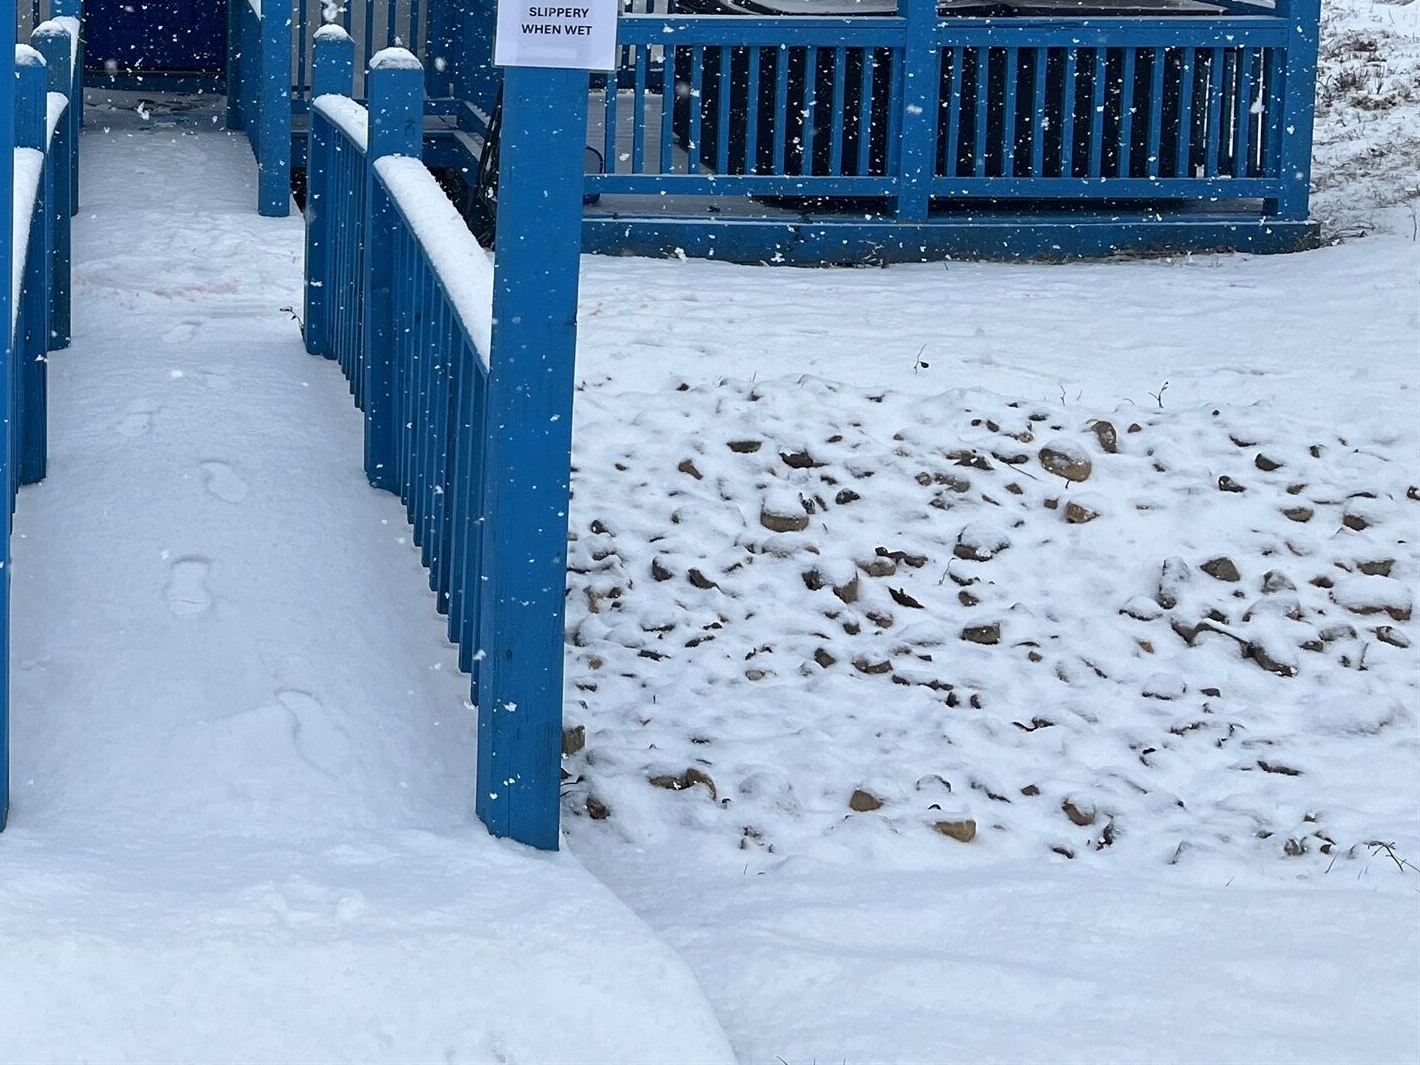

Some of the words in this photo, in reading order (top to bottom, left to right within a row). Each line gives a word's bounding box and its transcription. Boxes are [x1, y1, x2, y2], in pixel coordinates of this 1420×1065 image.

[529, 7, 589, 18] SLIPPERY
[522, 24, 561, 34] WHEN
[565, 25, 592, 35] WET
